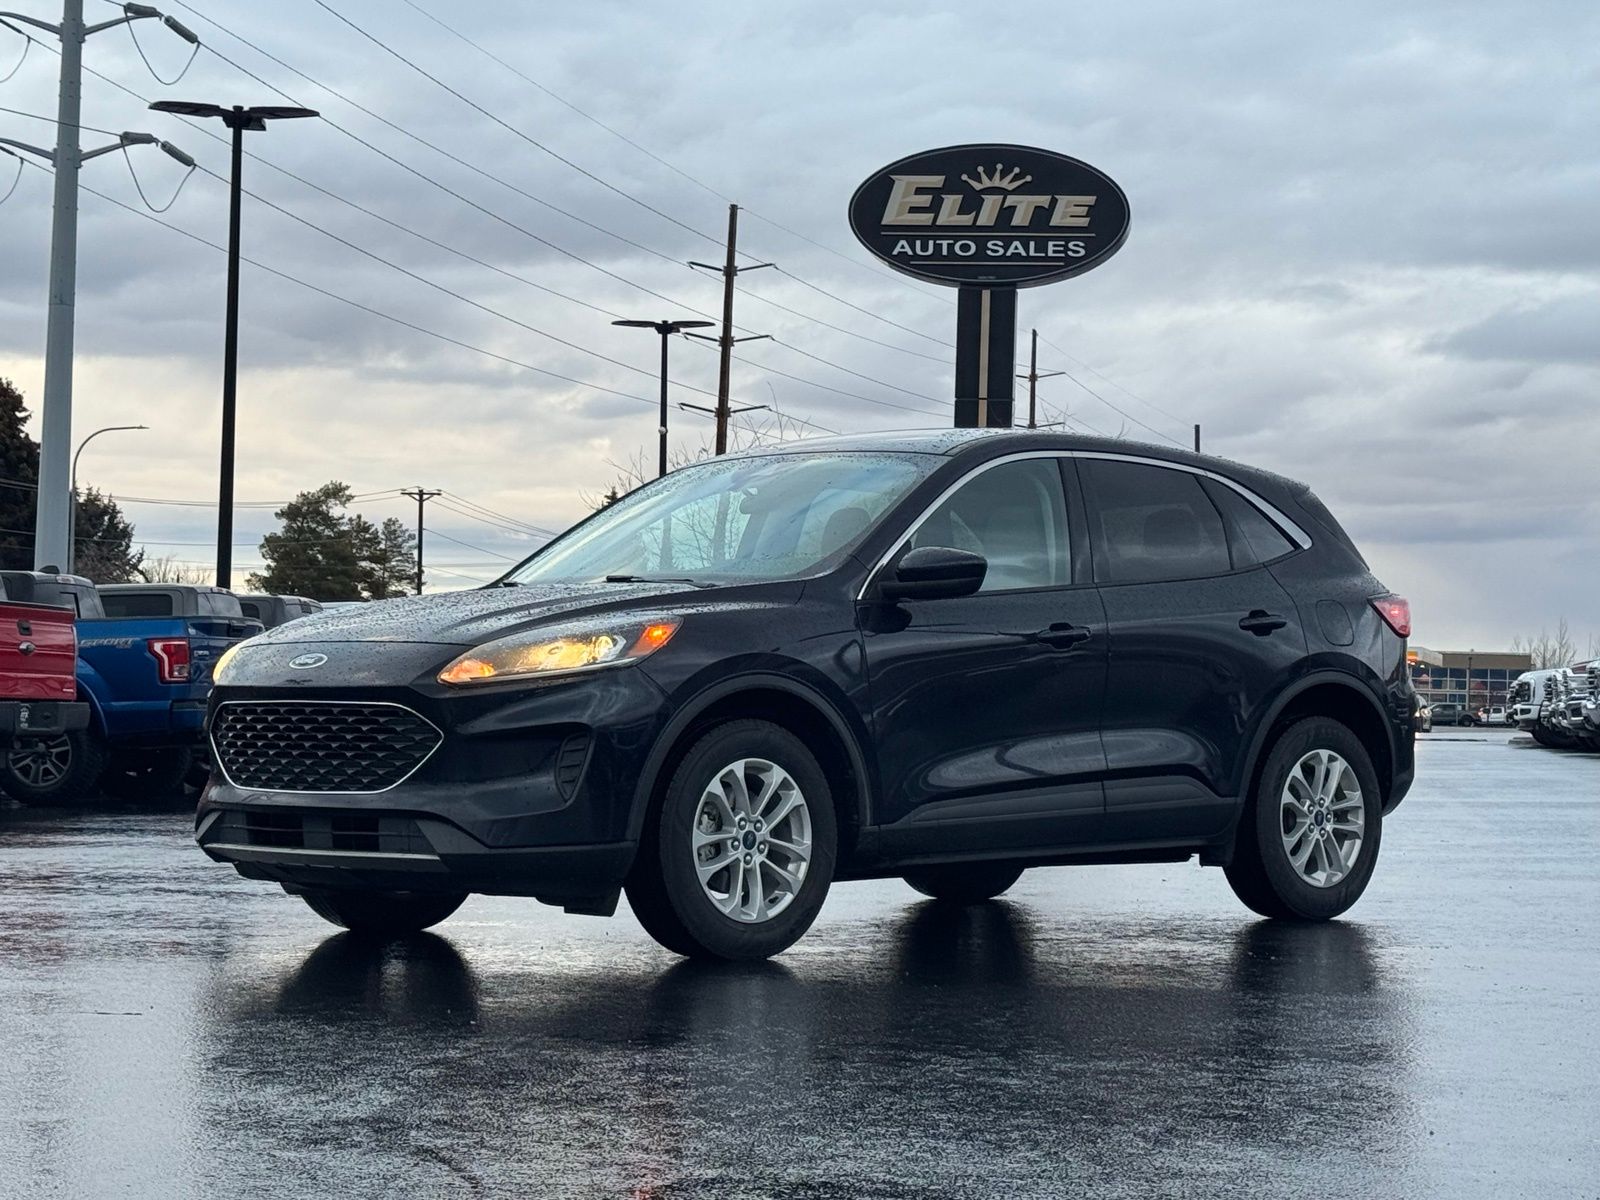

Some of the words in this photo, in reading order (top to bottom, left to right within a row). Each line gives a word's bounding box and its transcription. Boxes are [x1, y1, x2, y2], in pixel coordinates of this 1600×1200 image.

[880, 174, 1097, 227] ELITE
[891, 239, 977, 256] AUTO
[985, 240, 1086, 257] SALES
